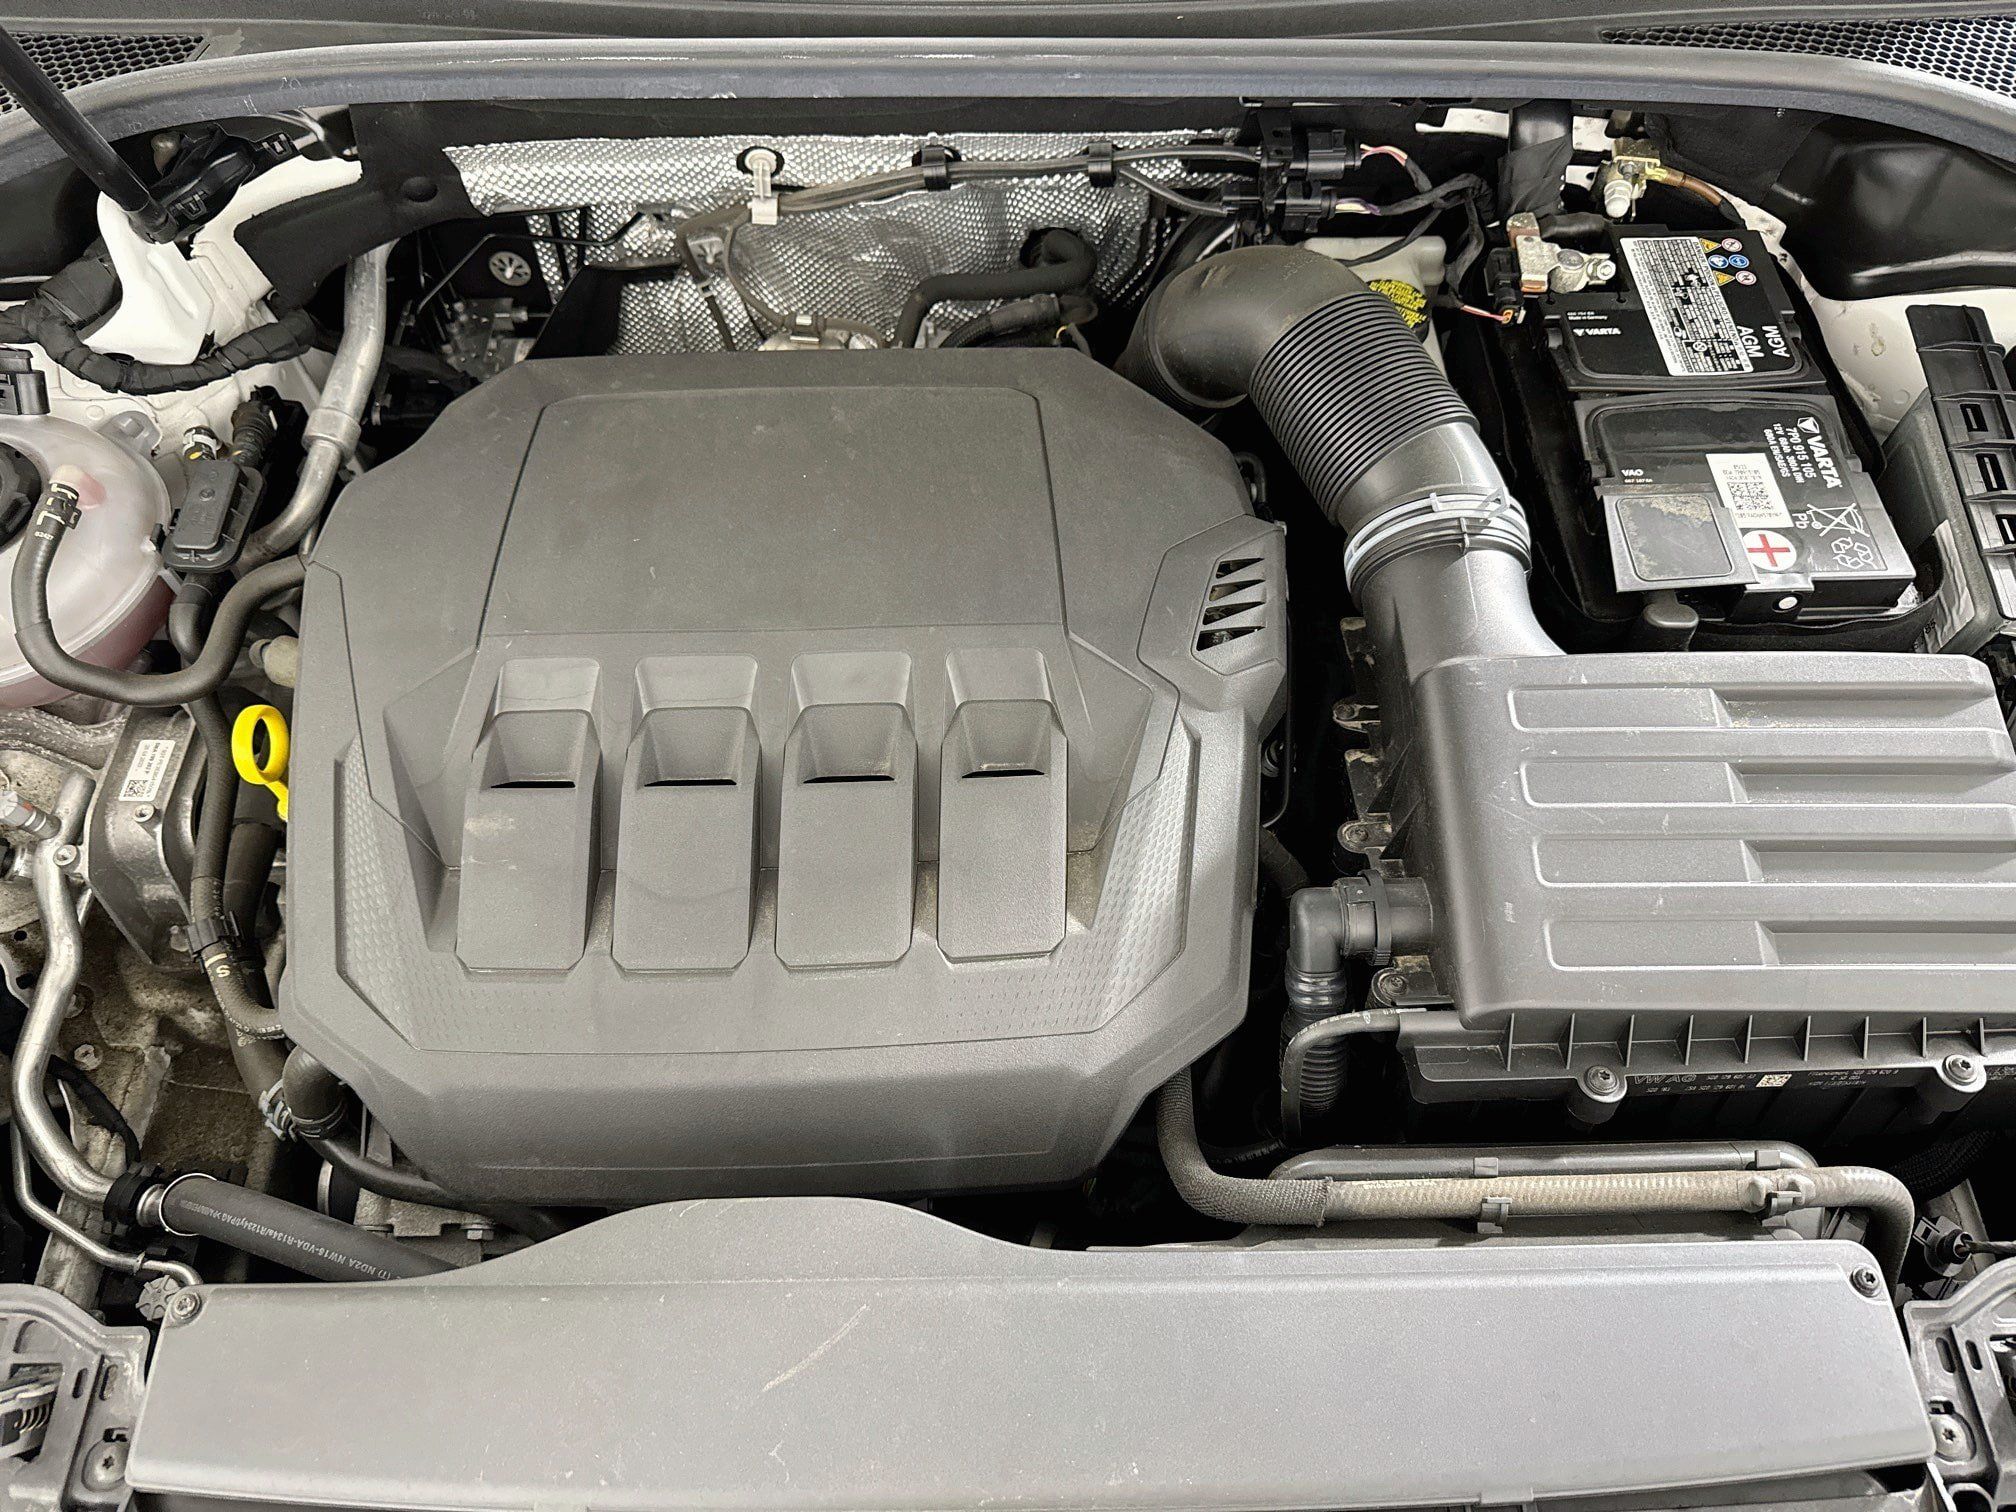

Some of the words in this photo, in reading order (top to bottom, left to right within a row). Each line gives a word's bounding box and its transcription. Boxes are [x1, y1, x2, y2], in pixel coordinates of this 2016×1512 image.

[1585, 327, 1622, 336] VARTA
[1736, 325, 1765, 358] AGM
[1761, 325, 1791, 358] AGM
[1772, 422, 1785, 435] 12V
[1785, 426, 1803, 444] 7P0
[1792, 444, 1810, 461] 915
[1806, 434, 1843, 489] VARTA
[1800, 462, 1818, 479] 105
[1791, 512, 1808, 529] Pb
[215, 963, 231, 978] S
[348, 1257, 377, 1276] ND2A
